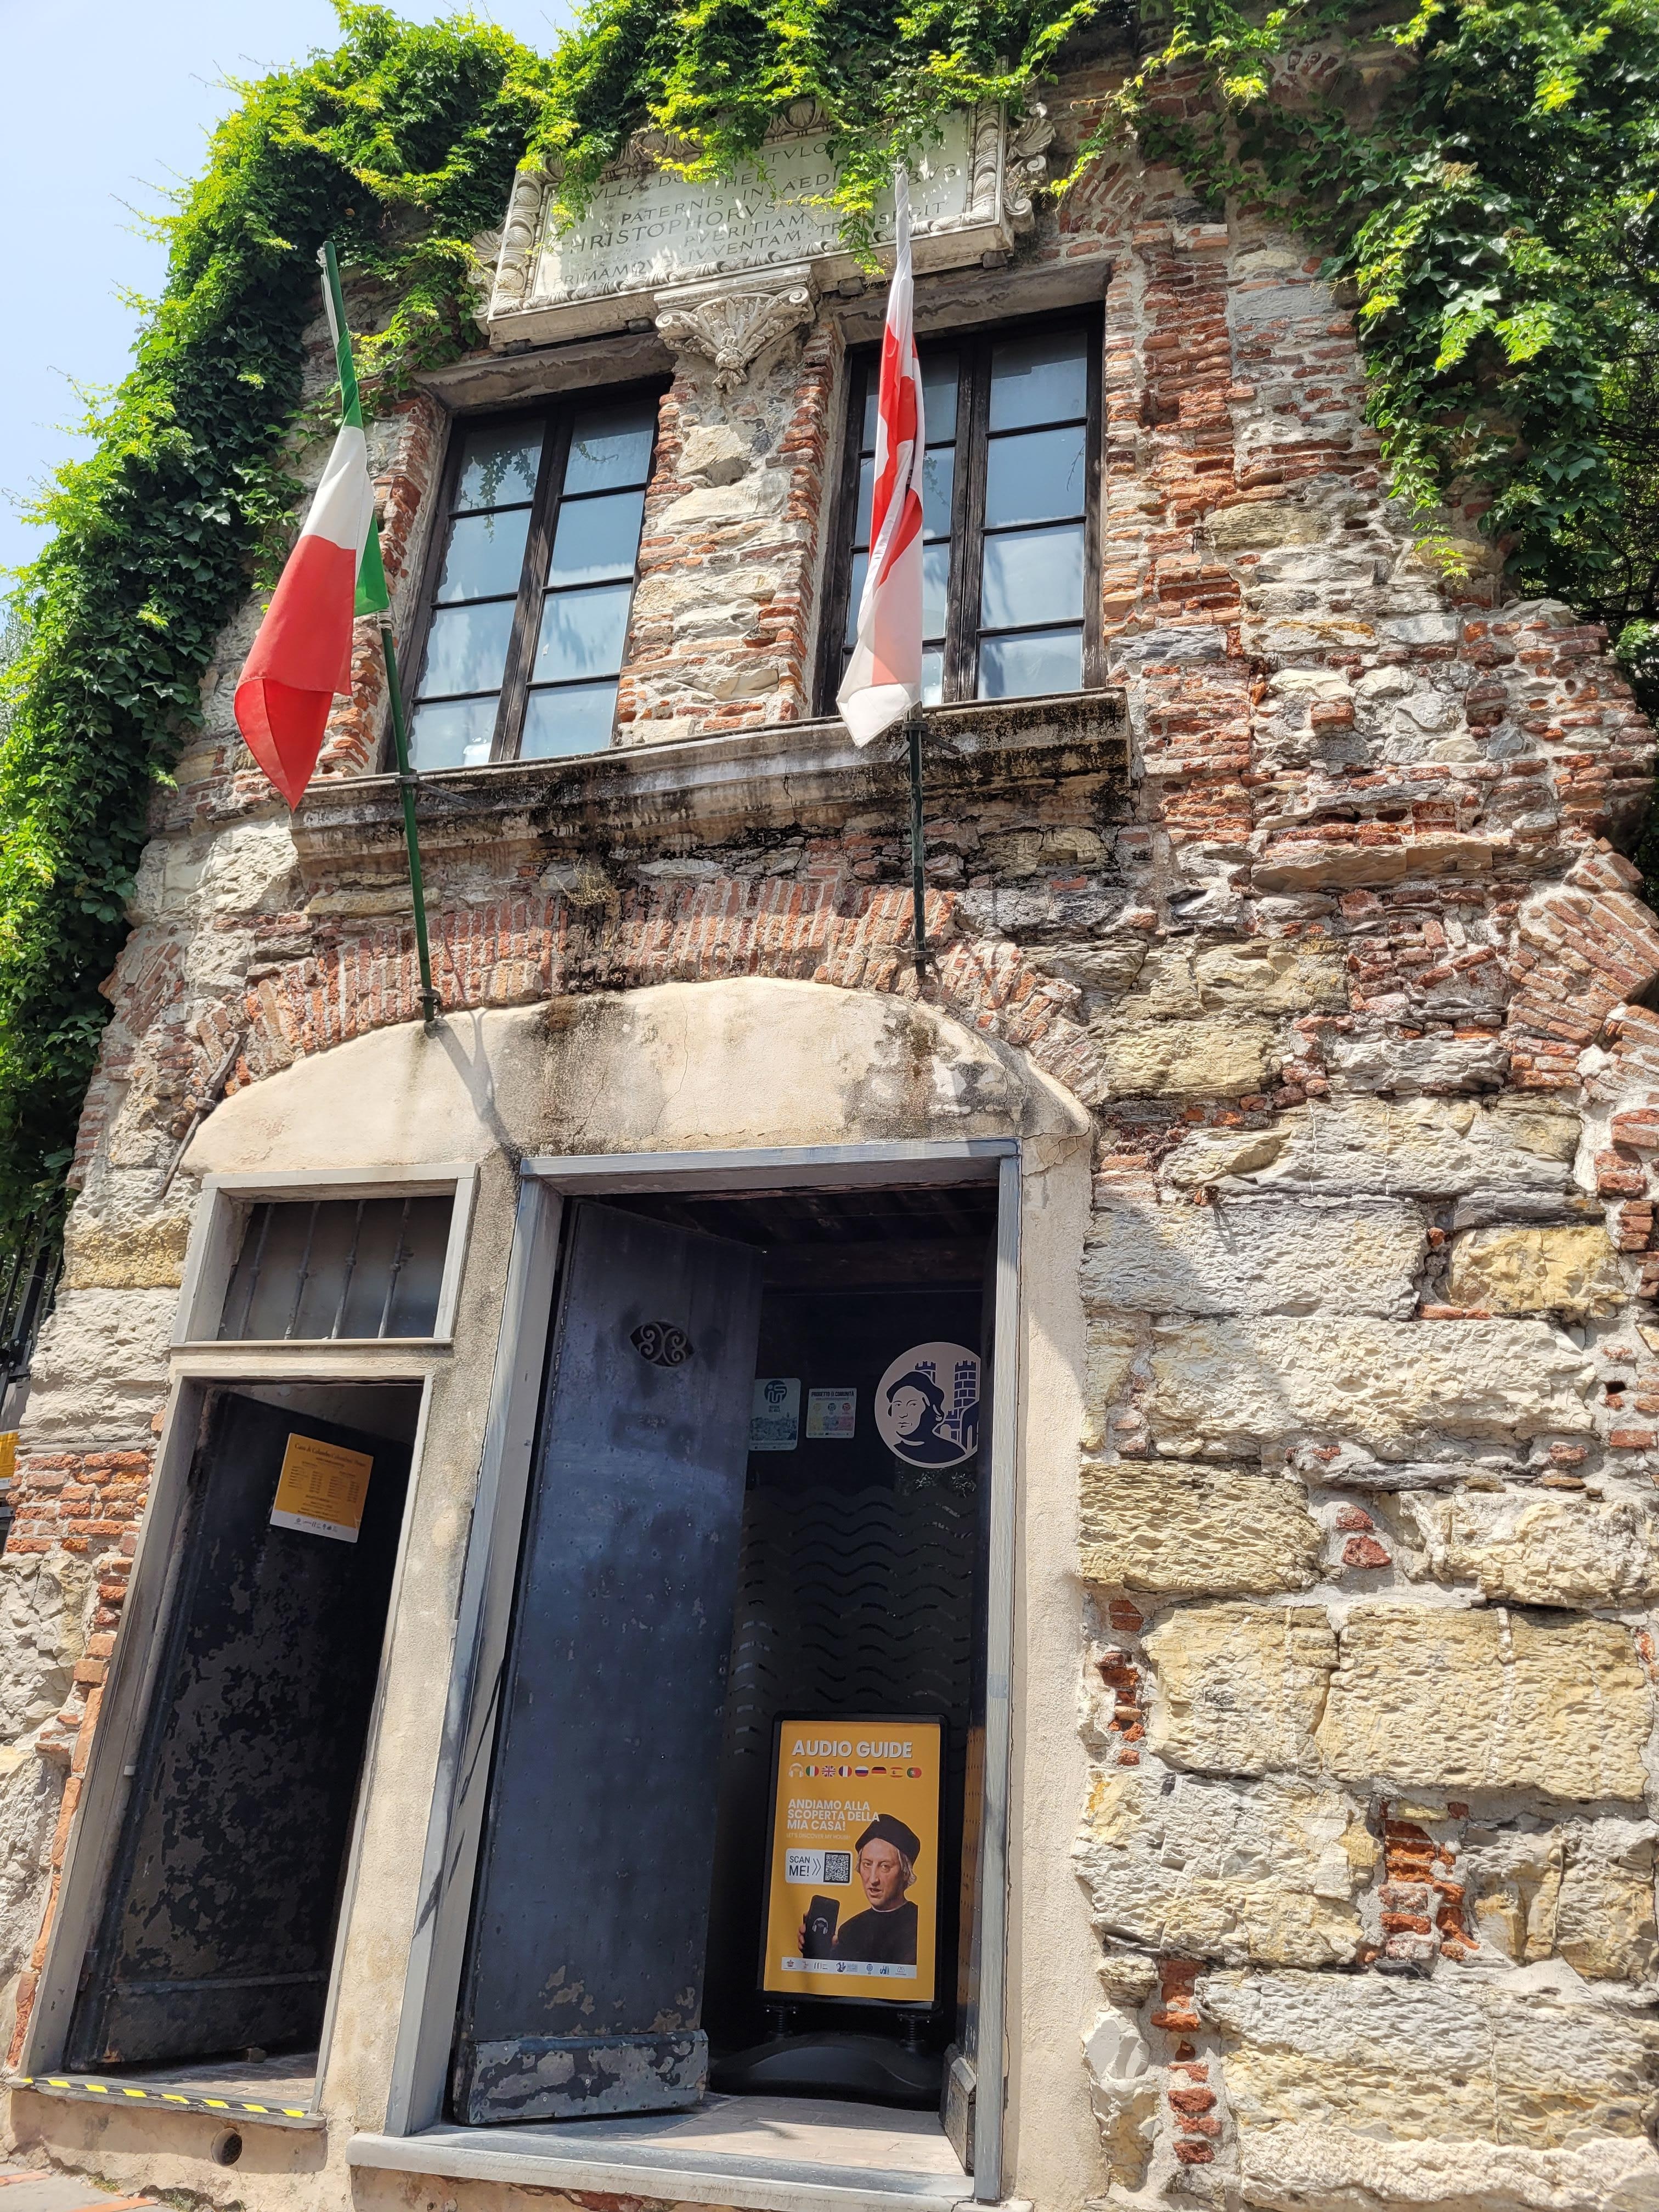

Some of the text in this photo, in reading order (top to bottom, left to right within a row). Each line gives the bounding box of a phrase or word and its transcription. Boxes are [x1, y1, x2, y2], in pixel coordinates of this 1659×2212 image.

[590, 143, 827, 200] VLLA ITVLO
[724, 168, 777, 189] HEIC
[621, 195, 724, 226] PATERNIS
[743, 187, 764, 200] IN
[550, 200, 775, 257] CHRISTOPHORVS
[685, 215, 804, 246] PVERITIAM
[689, 230, 801, 262] IVVENTAM
[792, 1740, 913, 1758] AUDIO GUIDE
[788, 1799, 870, 1811] ANDIAMO ALLA
[788, 1809, 880, 1822] SCOPERTA DELLA
[787, 1820, 846, 1831] MIA CASA!
[789, 1855, 810, 1864] SCAN
[789, 1865, 809, 1877] ME!
